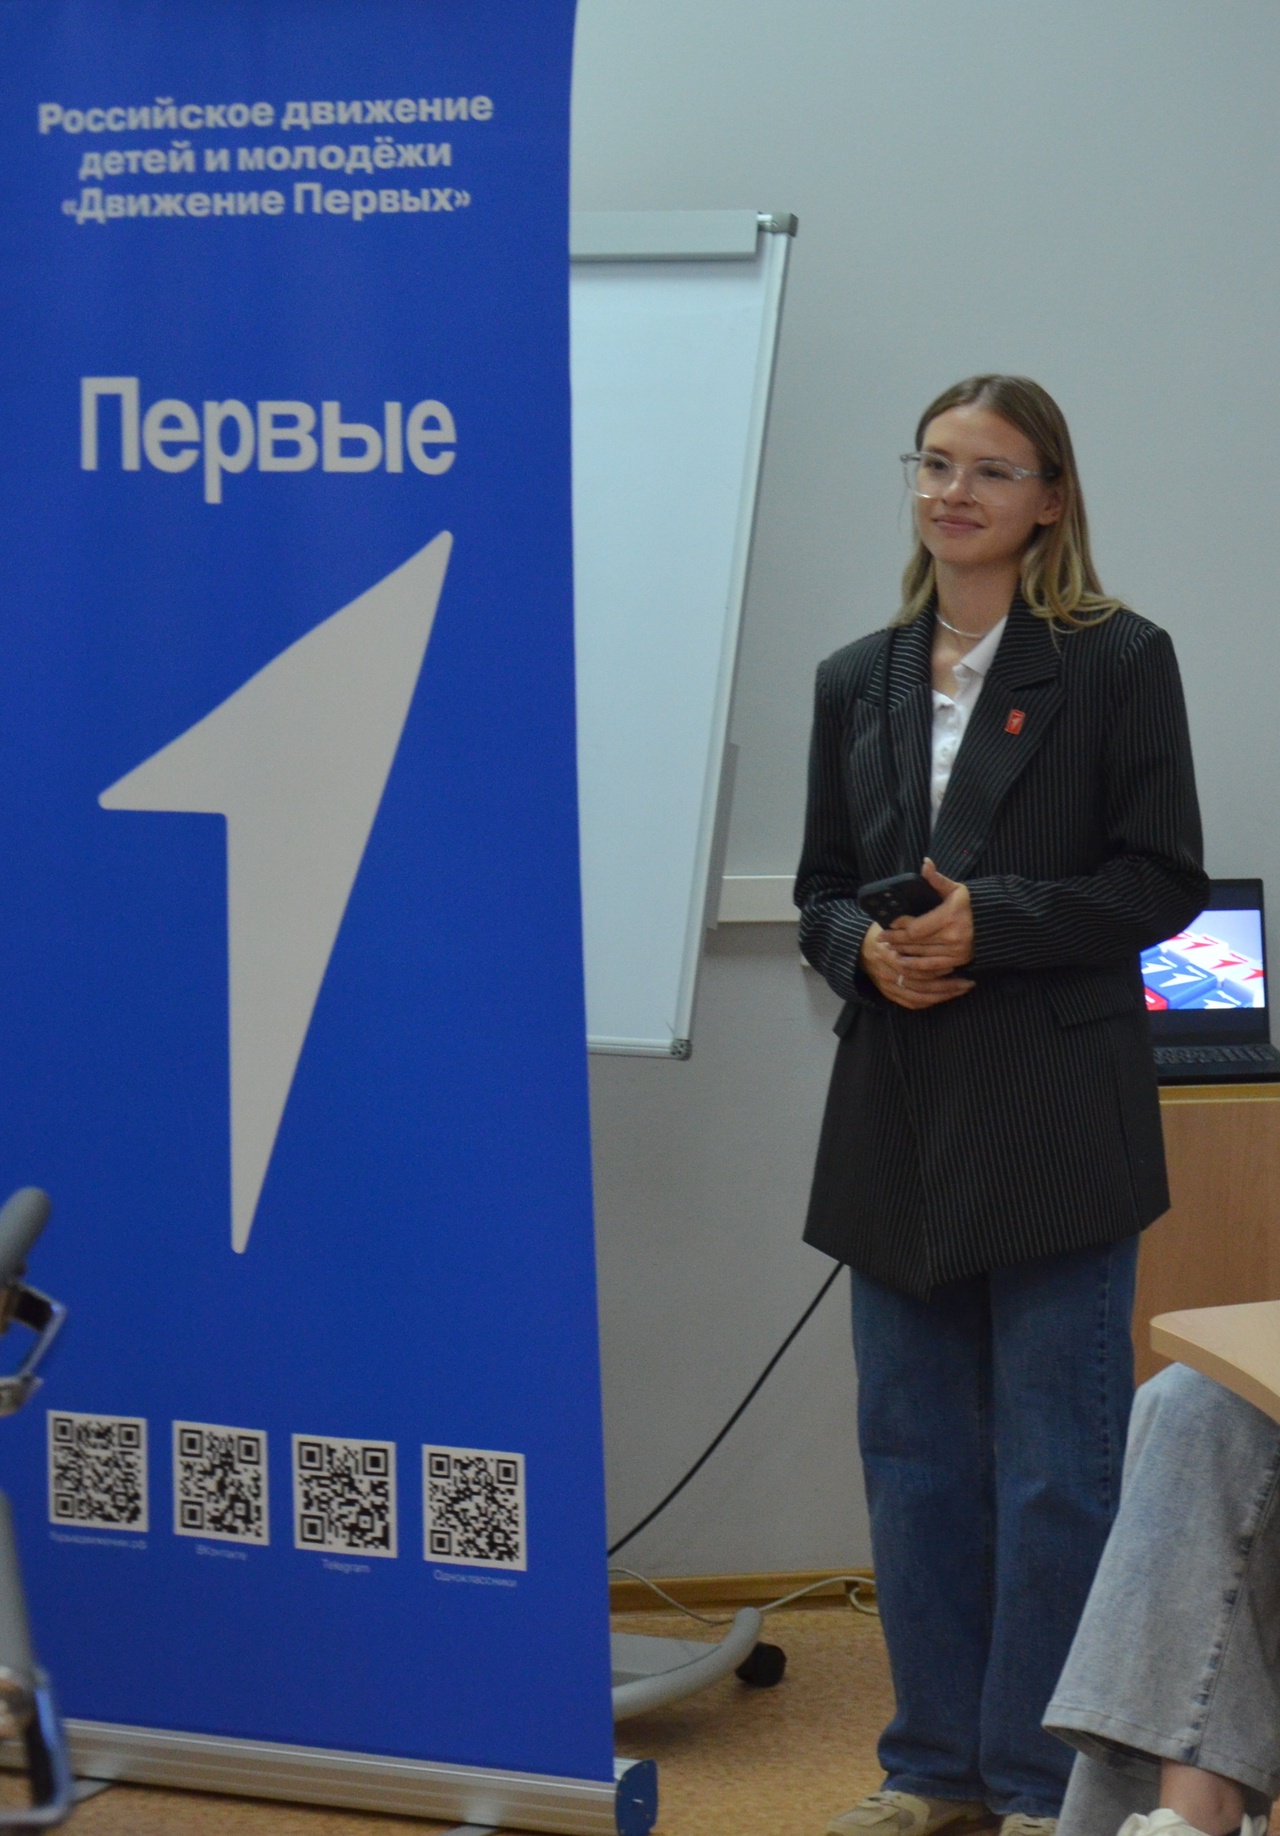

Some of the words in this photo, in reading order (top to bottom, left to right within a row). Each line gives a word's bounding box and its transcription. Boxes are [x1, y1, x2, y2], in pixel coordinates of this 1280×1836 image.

[38, 97, 275, 135] Российское
[281, 95, 494, 131] движение
[79, 140, 197, 181] детей
[204, 148, 230, 172] и
[237, 136, 452, 174] молодёжи
[61, 187, 286, 225] «Движение
[294, 182, 471, 221] Первых»
[80, 376, 457, 504] Первые
